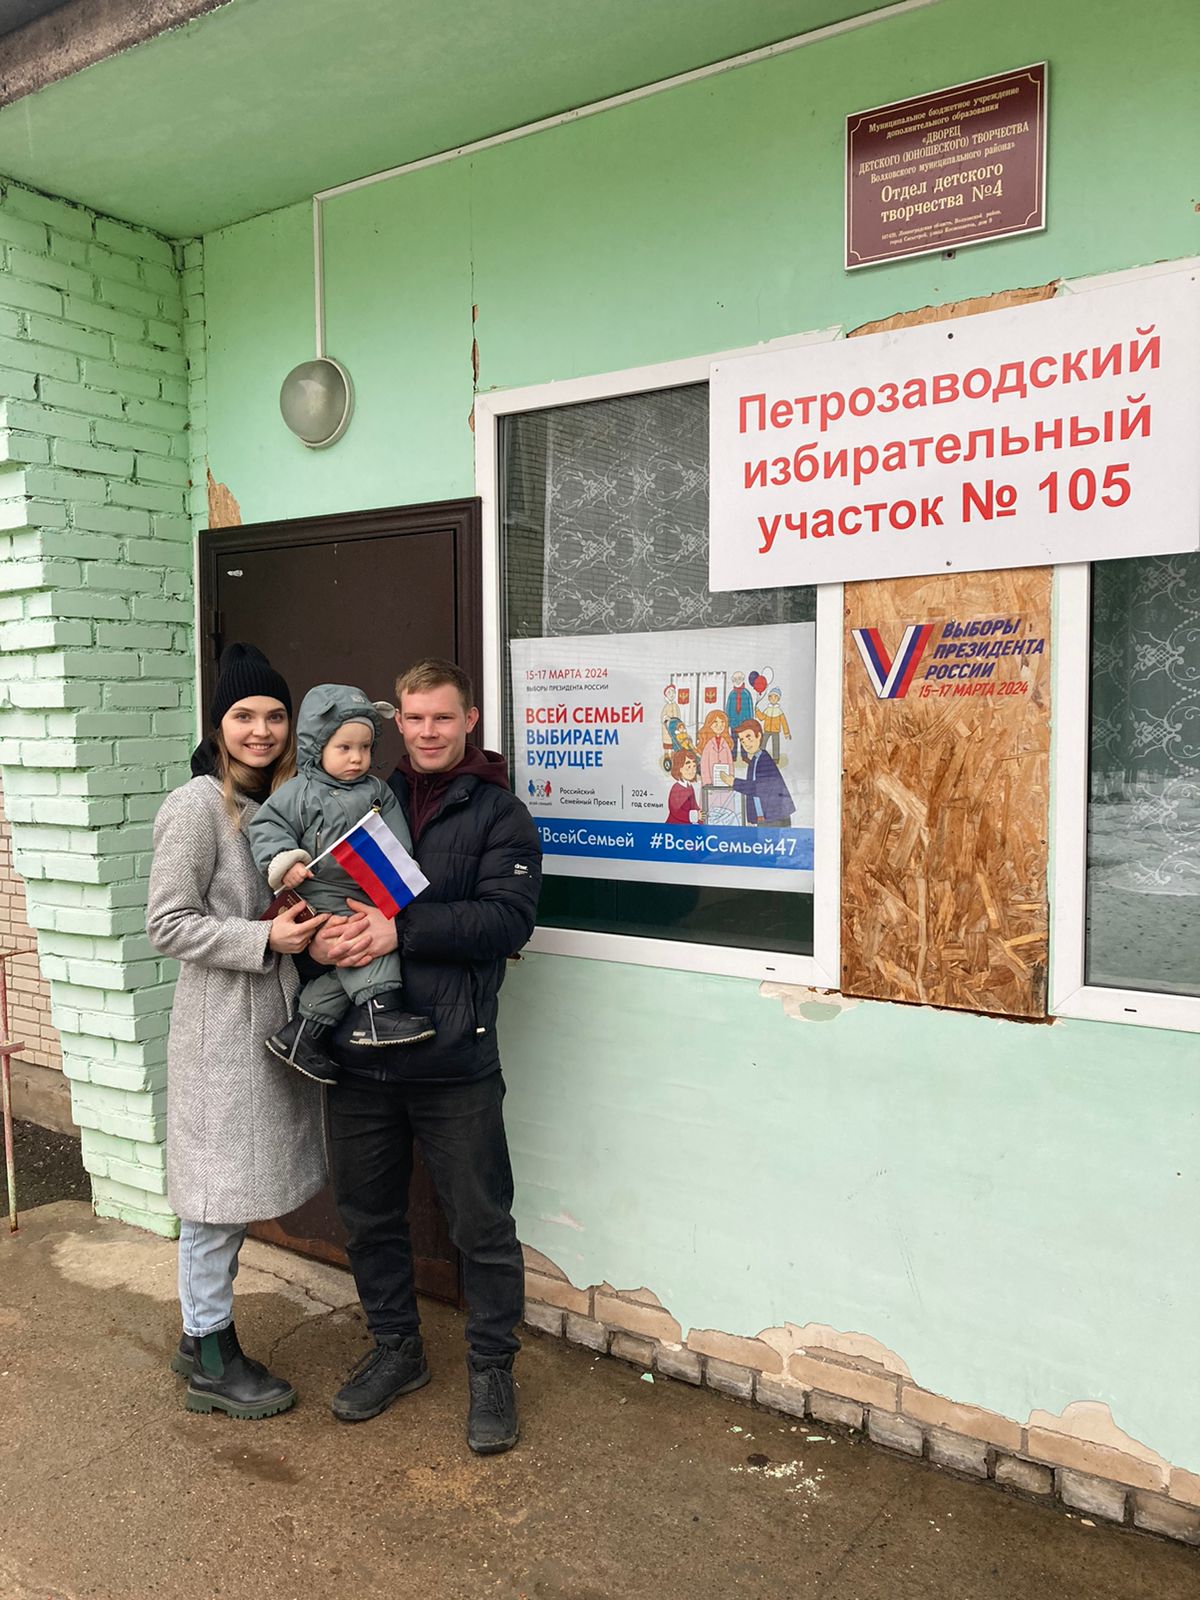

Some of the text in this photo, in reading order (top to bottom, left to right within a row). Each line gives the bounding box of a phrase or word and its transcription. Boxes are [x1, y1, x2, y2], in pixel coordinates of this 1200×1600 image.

[868, 86, 1020, 134] Муниципальное бюджетное учреждение
[886, 103, 999, 140] дополнительного образования
[922, 125, 961, 146] «ДВОРЕЦ
[858, 121, 1029, 175] ДЕТСКОГО (ЮНОШЕСКОГО) ТВОРЧЕСТВА
[870, 141, 1015, 184] Волховского муниципального района»
[881, 163, 1003, 203] Отдел детского
[881, 179, 1003, 223] творчества №4
[738, 324, 1161, 434] Петрозаводский
[744, 393, 1152, 489] избирательный
[757, 463, 1132, 553] участок № 105
[941, 618, 1022, 640] ВЫБОРЫ
[933, 638, 1045, 659] ПРЕЗИДЕНТА
[526, 668, 608, 680] 15-17 МАРТА 2024
[924, 662, 996, 680] РОССИИ
[952, 682, 994, 697] МАРТА
[997, 680, 1029, 695] 2024
[525, 702, 644, 723] ВСЕЙ СЕМЬЕЙ
[526, 729, 619, 745] ВЫБИРАЕМ
[527, 750, 603, 769] БУДУЩЕЕ
[560, 787, 595, 795] Российский
[560, 797, 592, 805] Семейный
[593, 798, 617, 807] Проект
[631, 789, 648, 797] 2024
[537, 826, 635, 848] ВсейСемьей
[650, 832, 798, 857] #ВсейСемьей47
